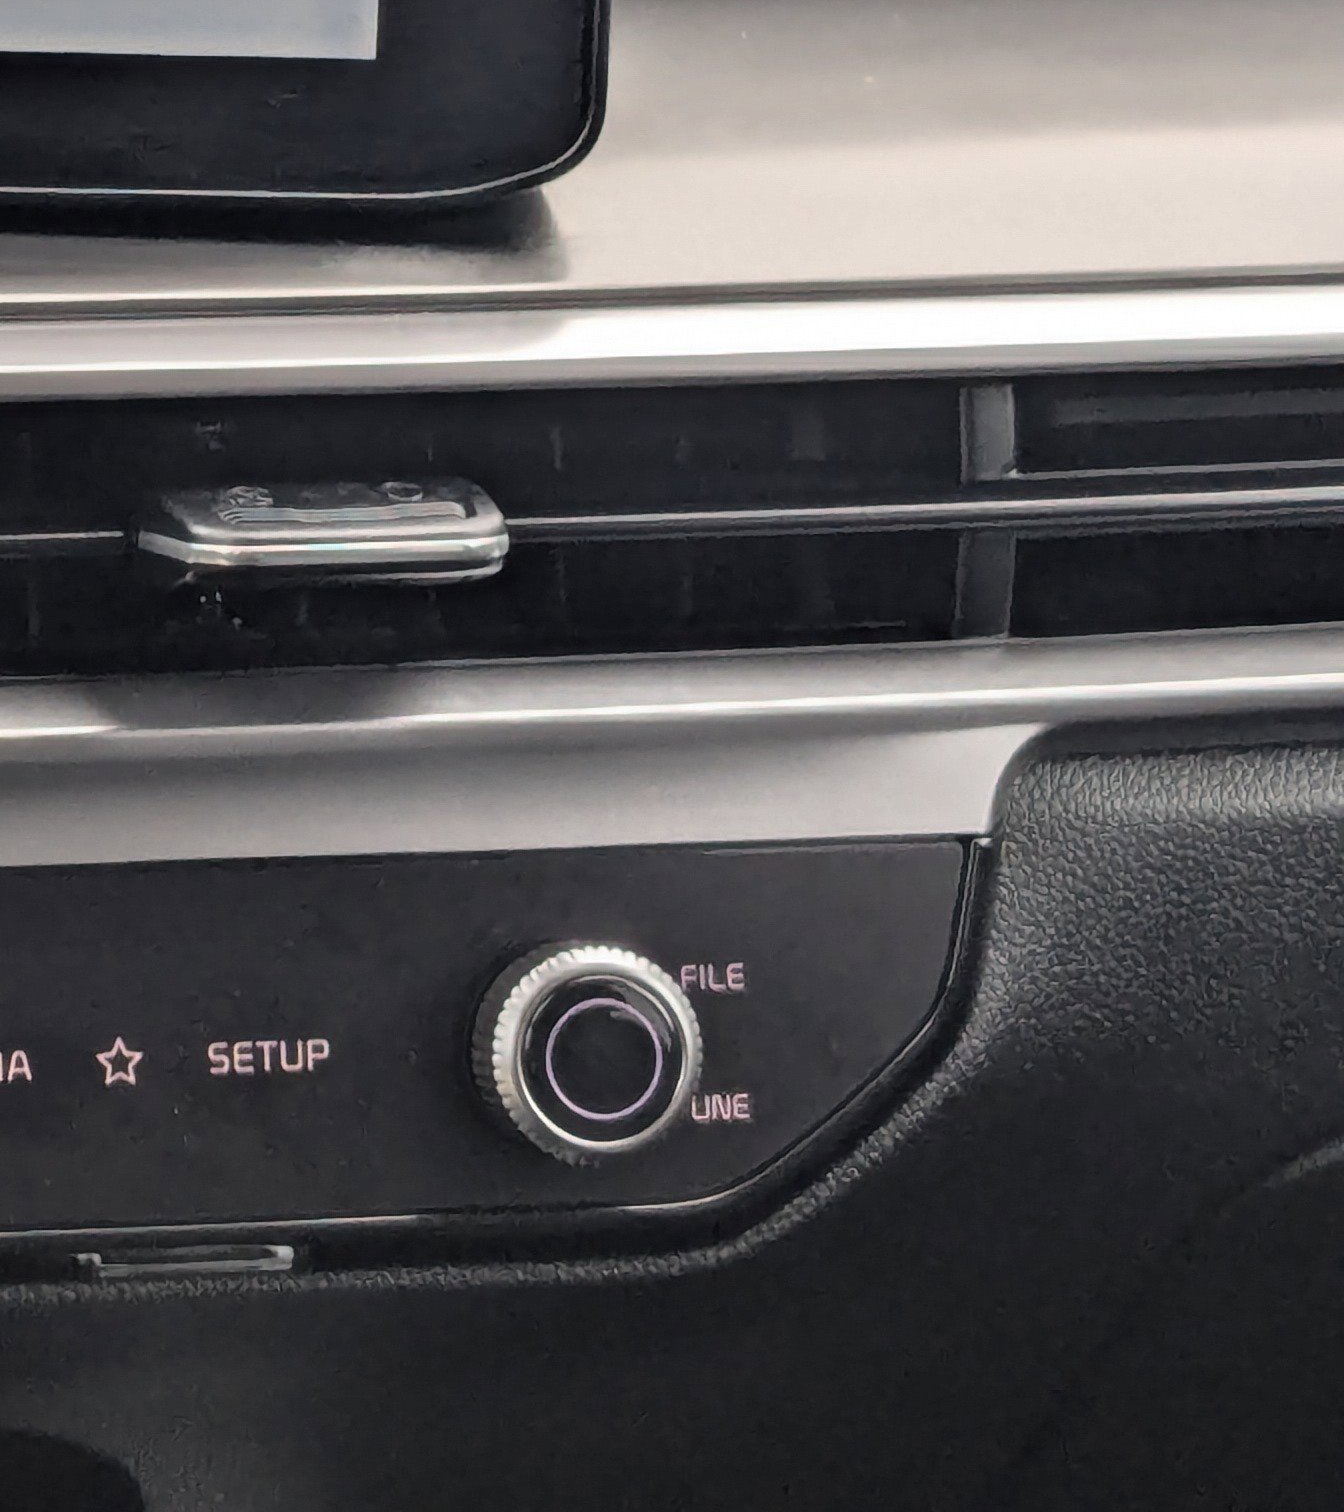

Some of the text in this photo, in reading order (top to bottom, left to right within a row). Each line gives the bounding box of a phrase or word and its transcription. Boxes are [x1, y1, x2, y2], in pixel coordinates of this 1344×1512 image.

[678, 962, 745, 997] FILE
[207, 1038, 330, 1074] SETUP
[691, 1093, 750, 1121] UNE
